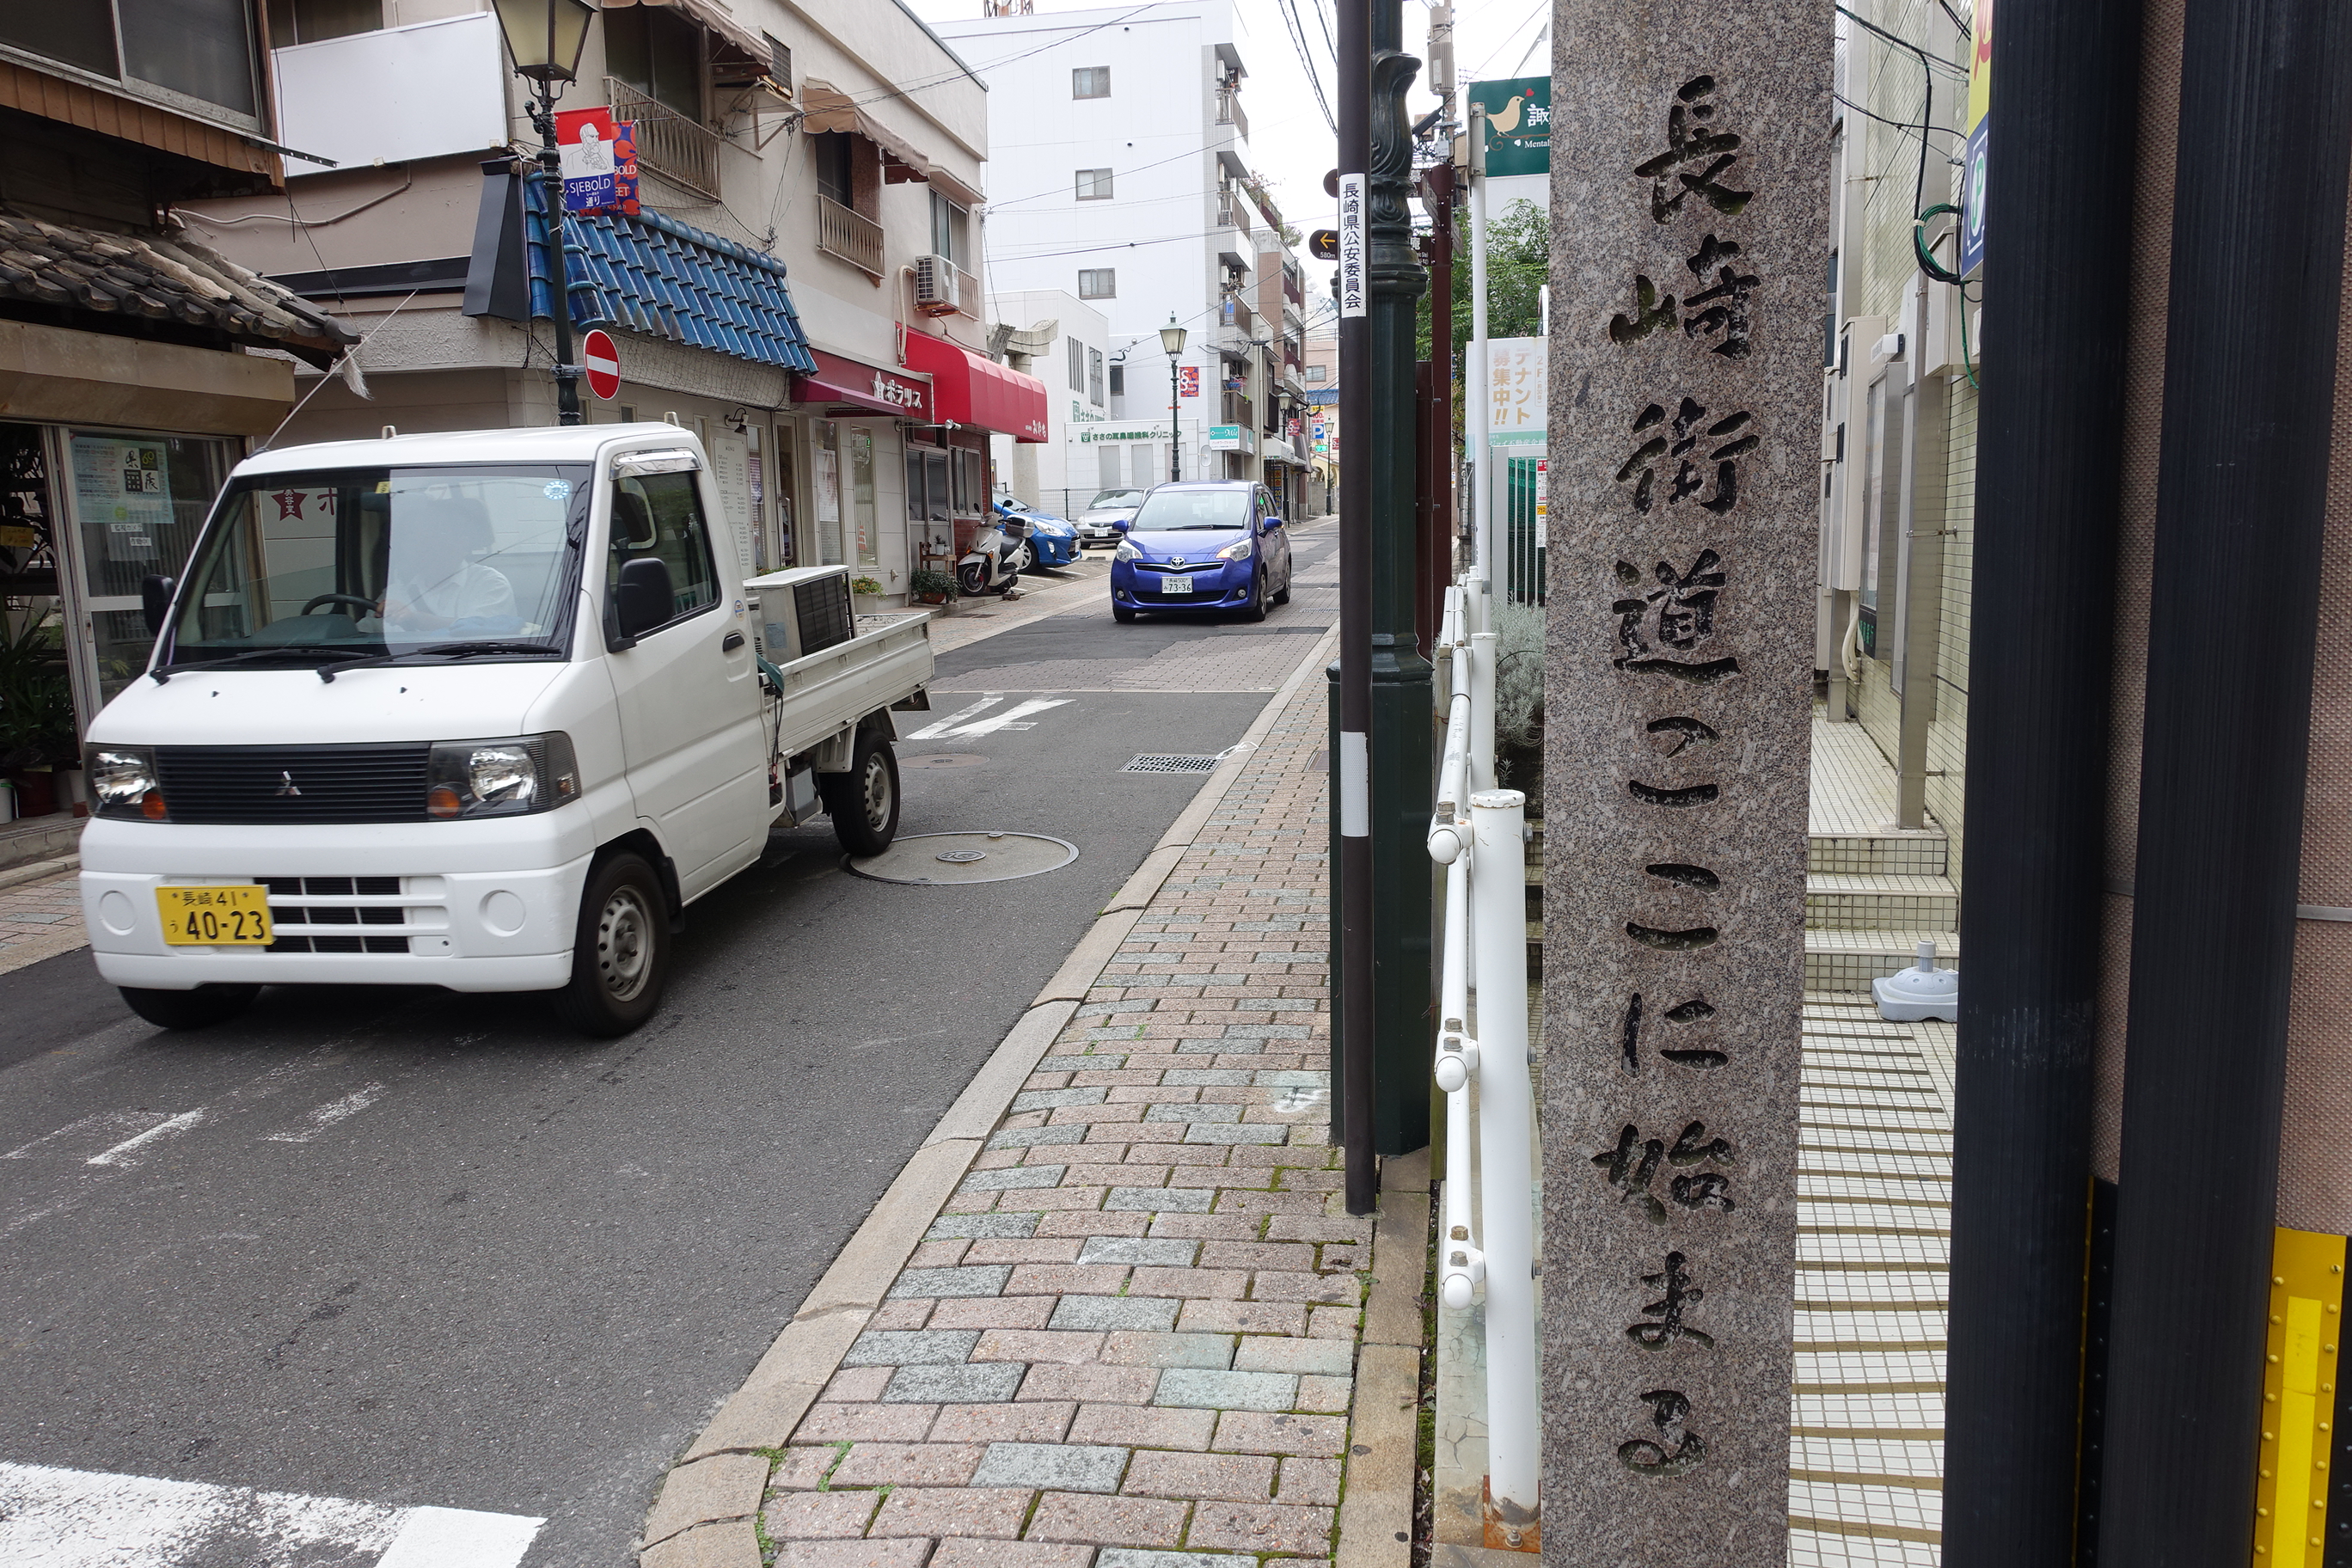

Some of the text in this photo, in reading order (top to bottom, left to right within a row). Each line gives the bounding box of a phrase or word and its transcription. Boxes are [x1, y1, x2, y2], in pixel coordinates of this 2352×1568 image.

[1527, 103, 1550, 127] 諏
[570, 175, 610, 197] SIEBOLD
[586, 196, 600, 206] 通り
[1344, 183, 1362, 309] 長崎県公安委員会
[885, 379, 922, 408] ポラリス
[1515, 347, 1532, 425] テナント
[1168, 583, 1191, 591] 73-36
[169, 919, 179, 934] う
[187, 910, 265, 940] 40-23
